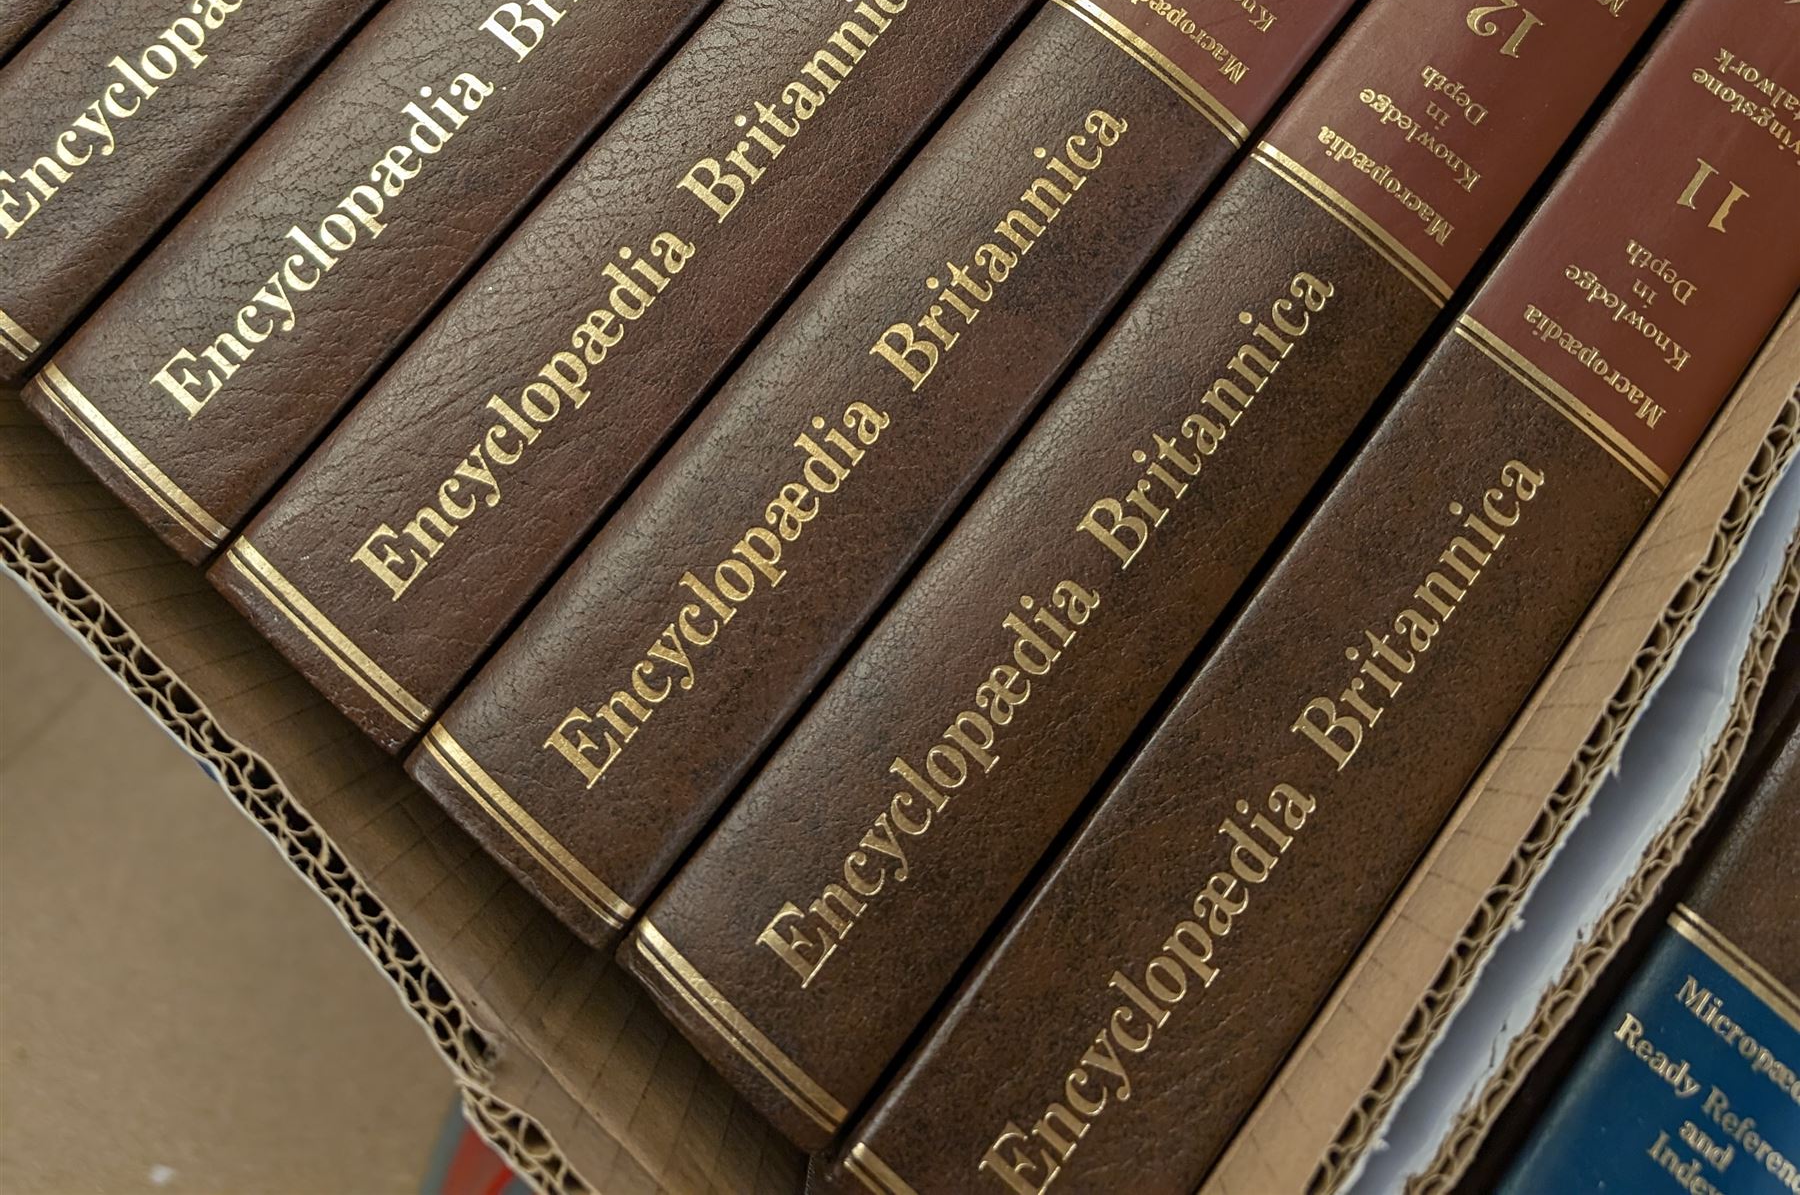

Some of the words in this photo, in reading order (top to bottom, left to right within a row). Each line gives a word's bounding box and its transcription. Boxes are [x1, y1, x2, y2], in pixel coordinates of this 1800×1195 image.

[1359, 87, 1482, 193] Knowledge
[1420, 64, 1489, 127] Depth
[1424, 100, 1450, 128] in
[1317, 125, 1456, 247] Macropædia
[1676, 157, 1751, 234] 11
[148, 69, 494, 421] Encyclopædia
[1624, 238, 1698, 307] Depth
[1631, 278, 1658, 309] in
[1522, 303, 1668, 430] Macropædia
[1564, 263, 1692, 373] Knowledge
[349, 226, 696, 604] Encyclopædia
[541, 398, 890, 792] Encyclopædia
[868, 103, 1130, 393] Britannica
[754, 573, 1101, 990] Encyclopædia
[1075, 264, 1335, 570] Britannica
[978, 774, 1317, 1195] Encyclopædia
[1289, 451, 1546, 773] Britannica
[1614, 1012, 1700, 1098] Ready
[1679, 1120, 1735, 1172] and
